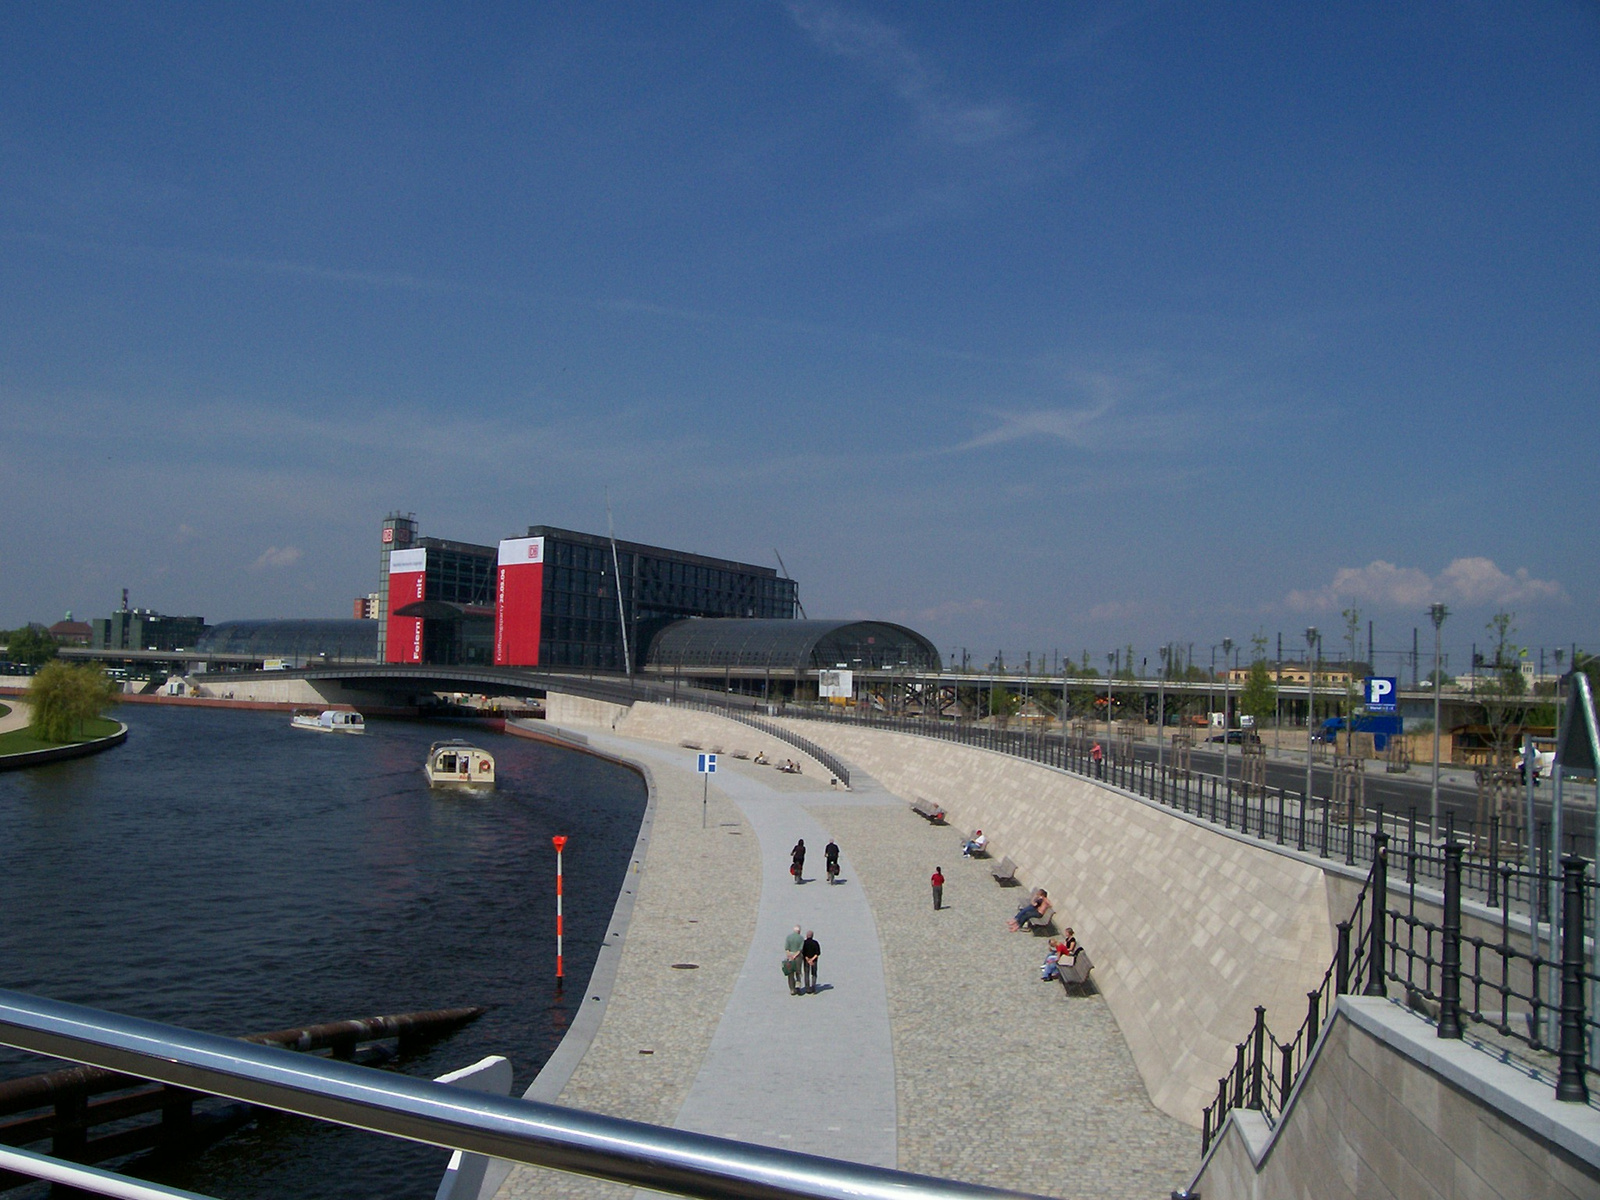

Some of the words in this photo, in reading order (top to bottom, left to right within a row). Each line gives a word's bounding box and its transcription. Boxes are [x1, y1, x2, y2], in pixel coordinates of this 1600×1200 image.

[383, 529, 393, 542] DB
[529, 546, 538, 558] DB
[413, 621, 421, 660] Feiern
[1371, 679, 1391, 702] P
